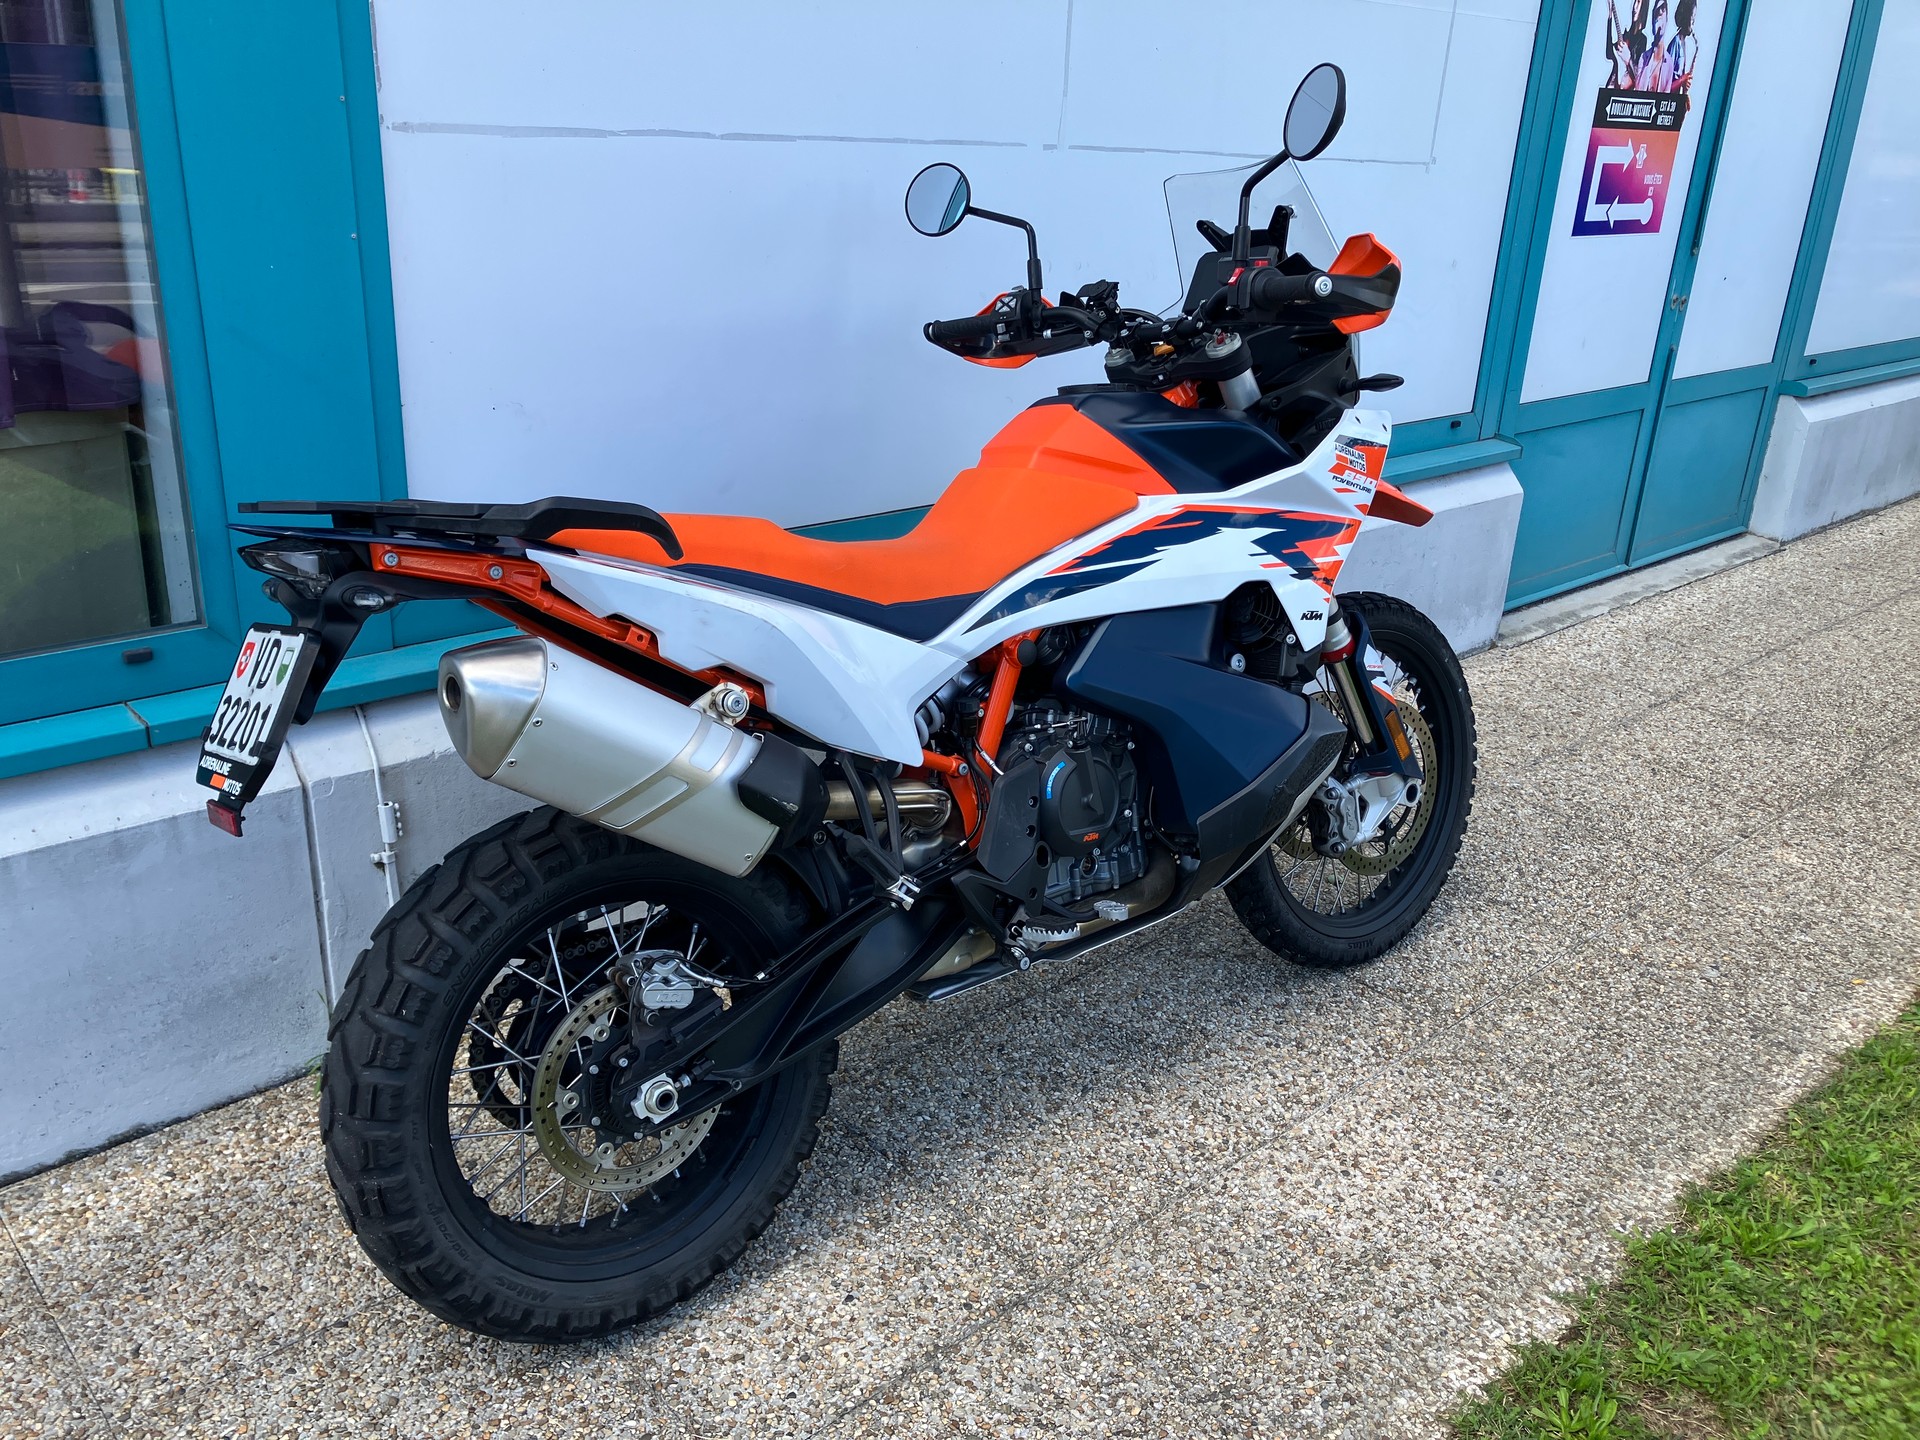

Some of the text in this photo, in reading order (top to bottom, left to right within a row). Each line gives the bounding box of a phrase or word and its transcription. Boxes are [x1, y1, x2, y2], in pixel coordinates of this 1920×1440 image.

[1659, 100, 1668, 112] EST
[1670, 101, 1677, 112] 30
[1334, 443, 1366, 462] ADRENALINE
[1349, 458, 1366, 472] MOTOS
[1332, 475, 1373, 494] ADVENTURE
[1300, 610, 1324, 621] KTM
[247, 636, 282, 690] VD
[208, 694, 273, 756] 32201
[199, 754, 233, 776] ADRENALINE
[221, 777, 243, 796] MOTOS
[1082, 832, 1100, 842] KTM
[442, 925, 503, 1008] ENDURO
